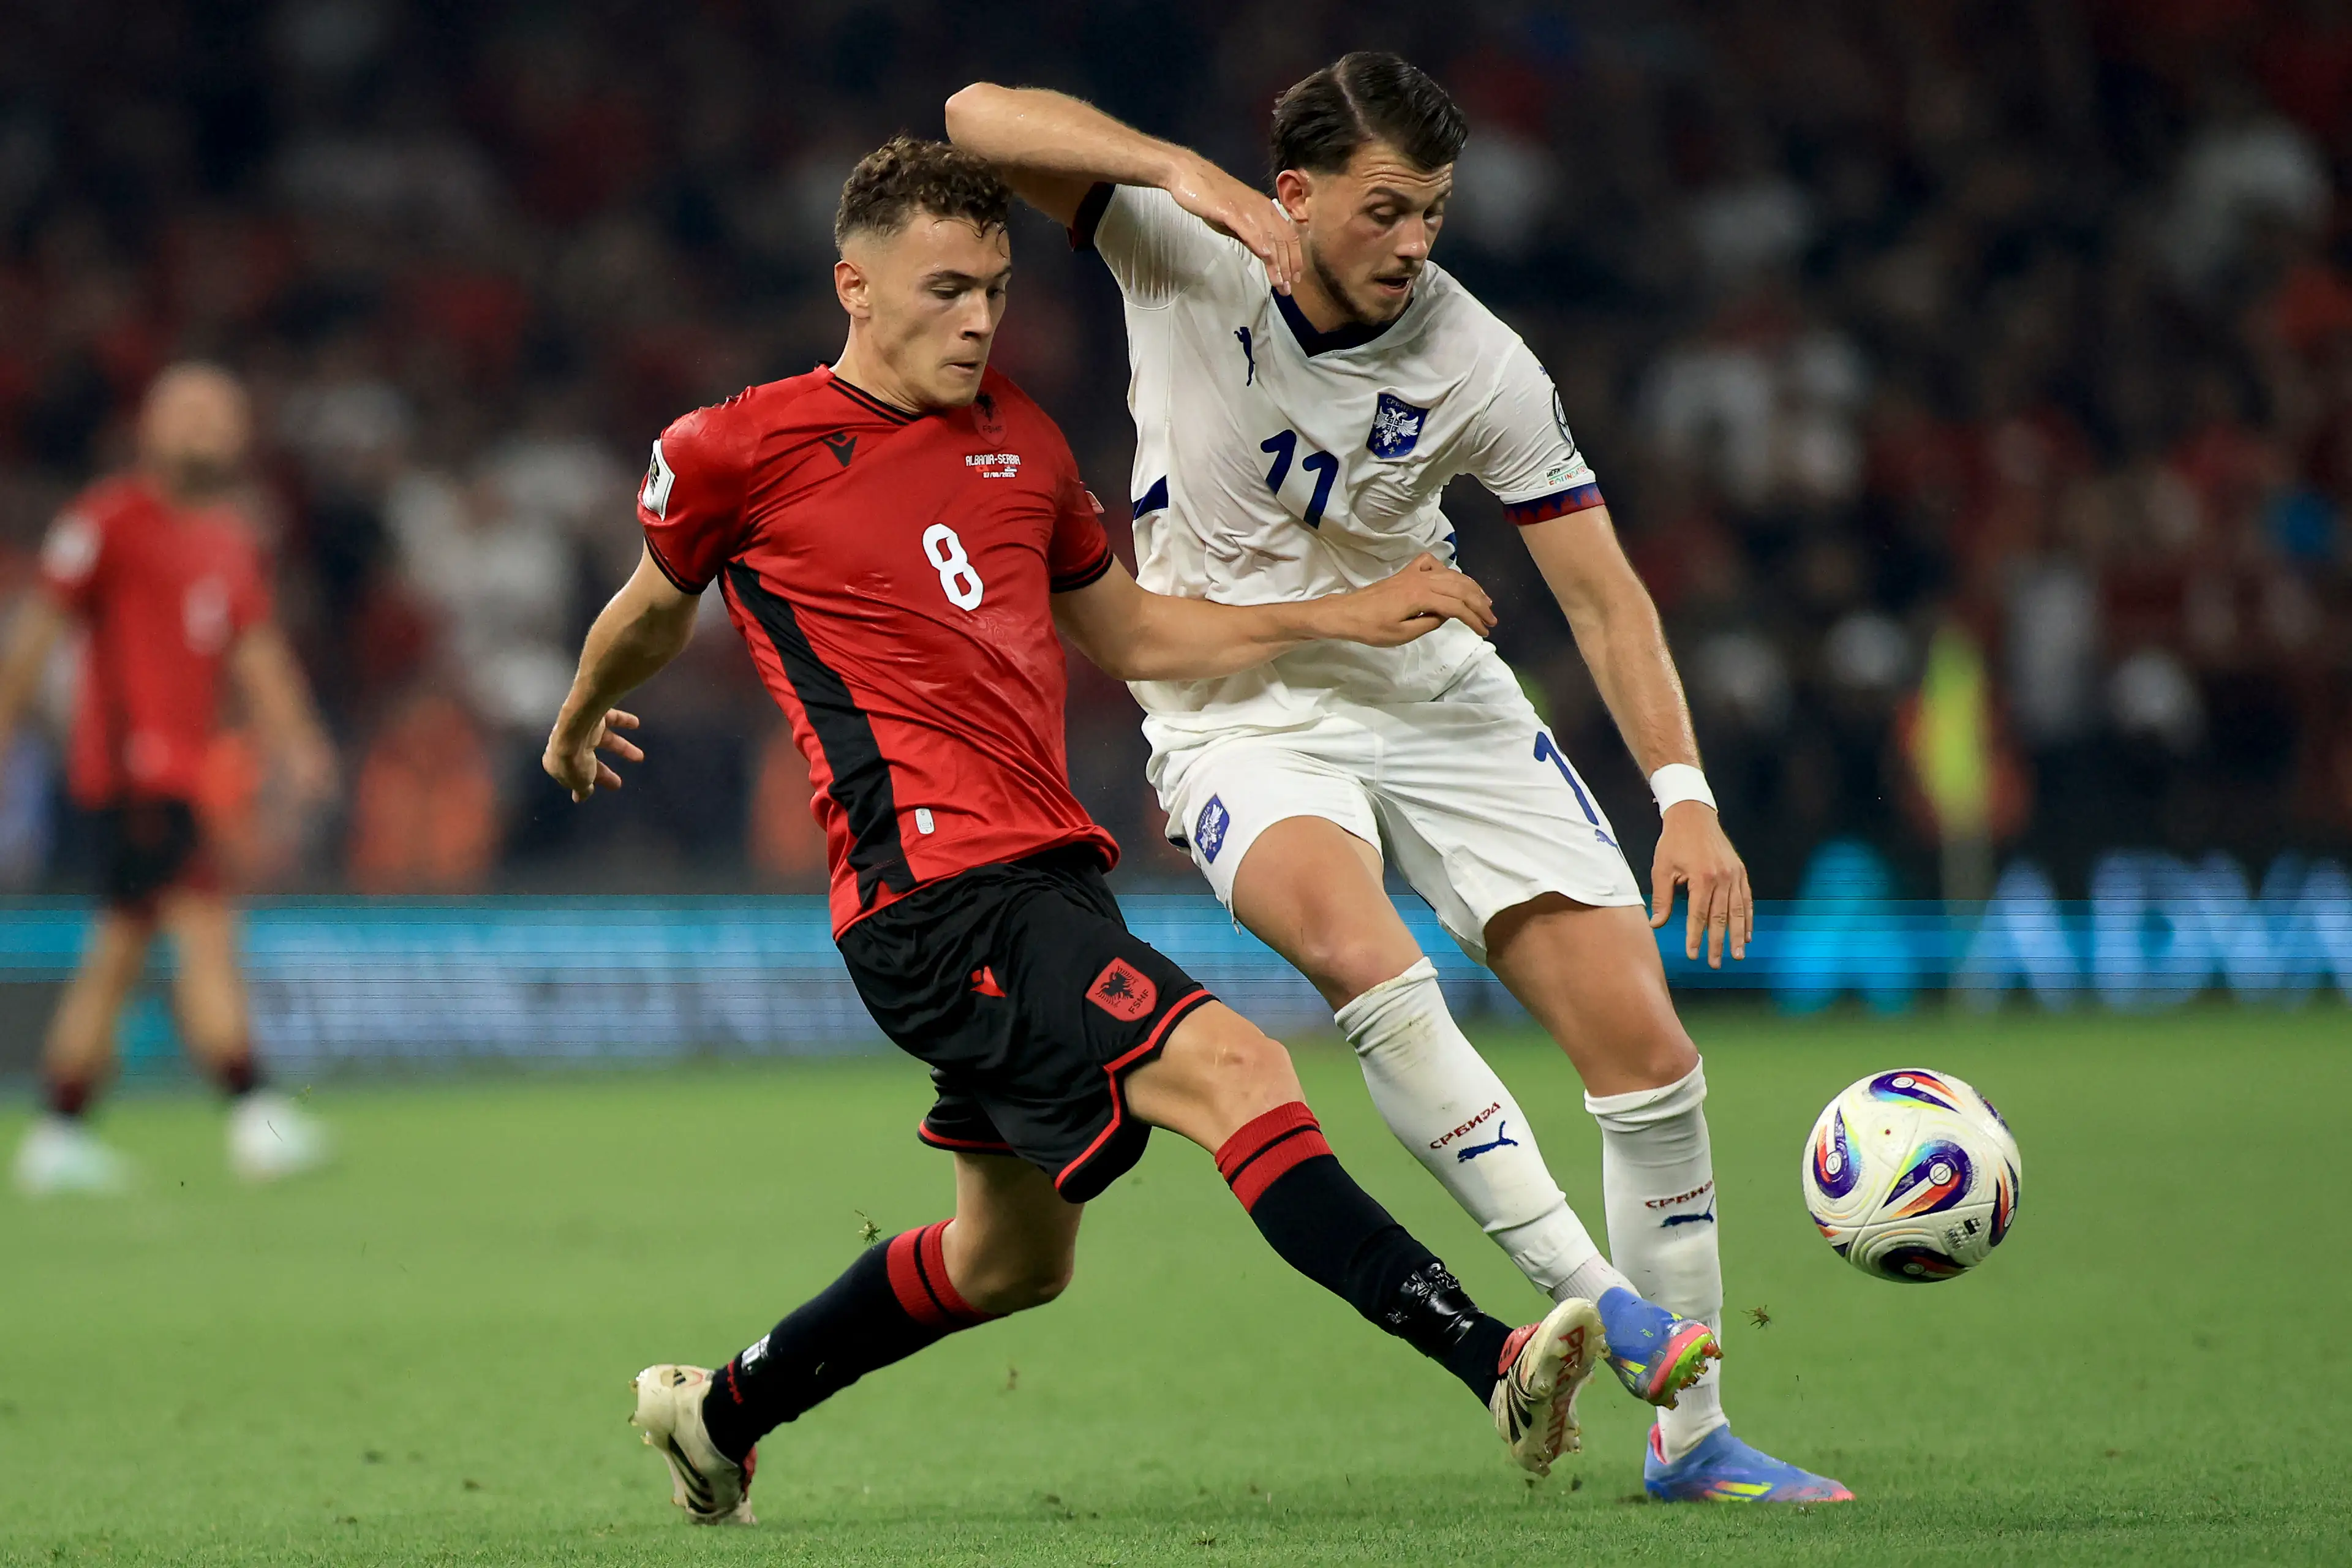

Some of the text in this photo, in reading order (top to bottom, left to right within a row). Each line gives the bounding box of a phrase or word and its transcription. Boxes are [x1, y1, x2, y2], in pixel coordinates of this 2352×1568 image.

[965, 453, 1021, 466] ALBANIA-SERBIA
[1260, 429, 1339, 530] 11
[922, 524, 983, 611] 8
[1128, 989, 1148, 1014] FSHF
